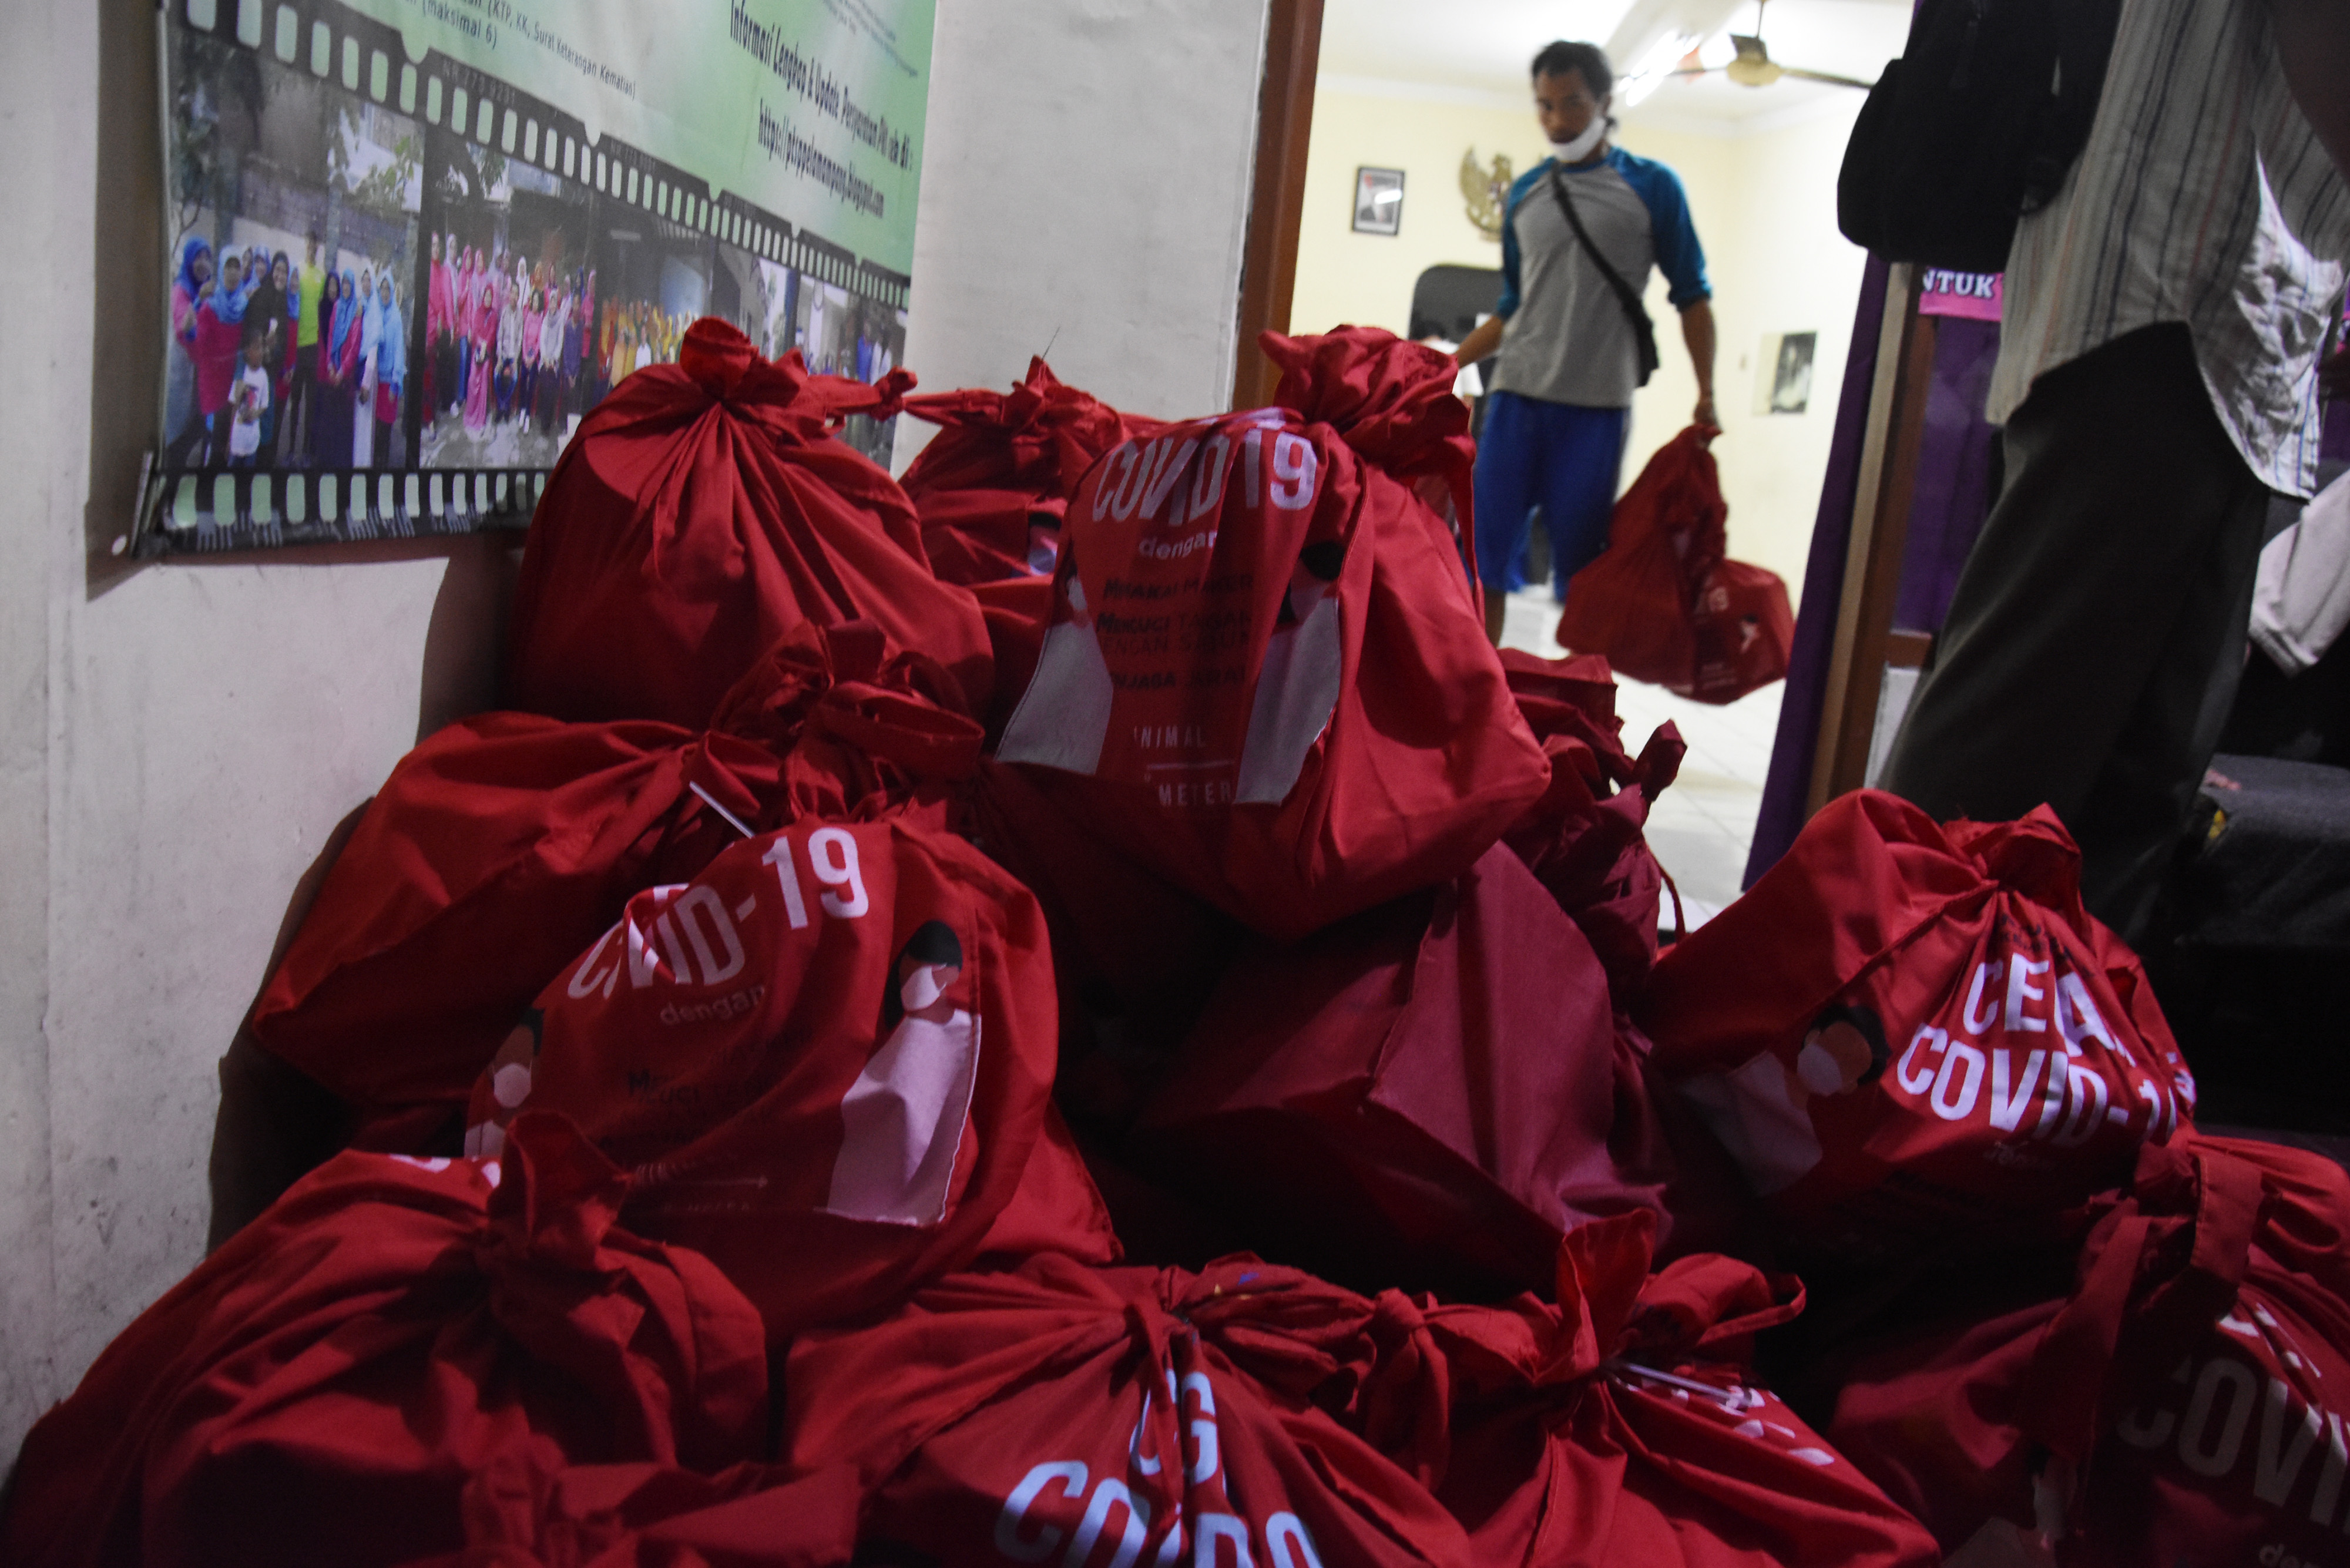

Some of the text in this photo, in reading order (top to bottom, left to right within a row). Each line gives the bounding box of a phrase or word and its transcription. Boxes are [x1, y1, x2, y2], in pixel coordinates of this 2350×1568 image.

[534, 21, 555, 52] Surat
[557, 36, 596, 78] Keterangan
[600, 63, 636, 102] Kematian)
